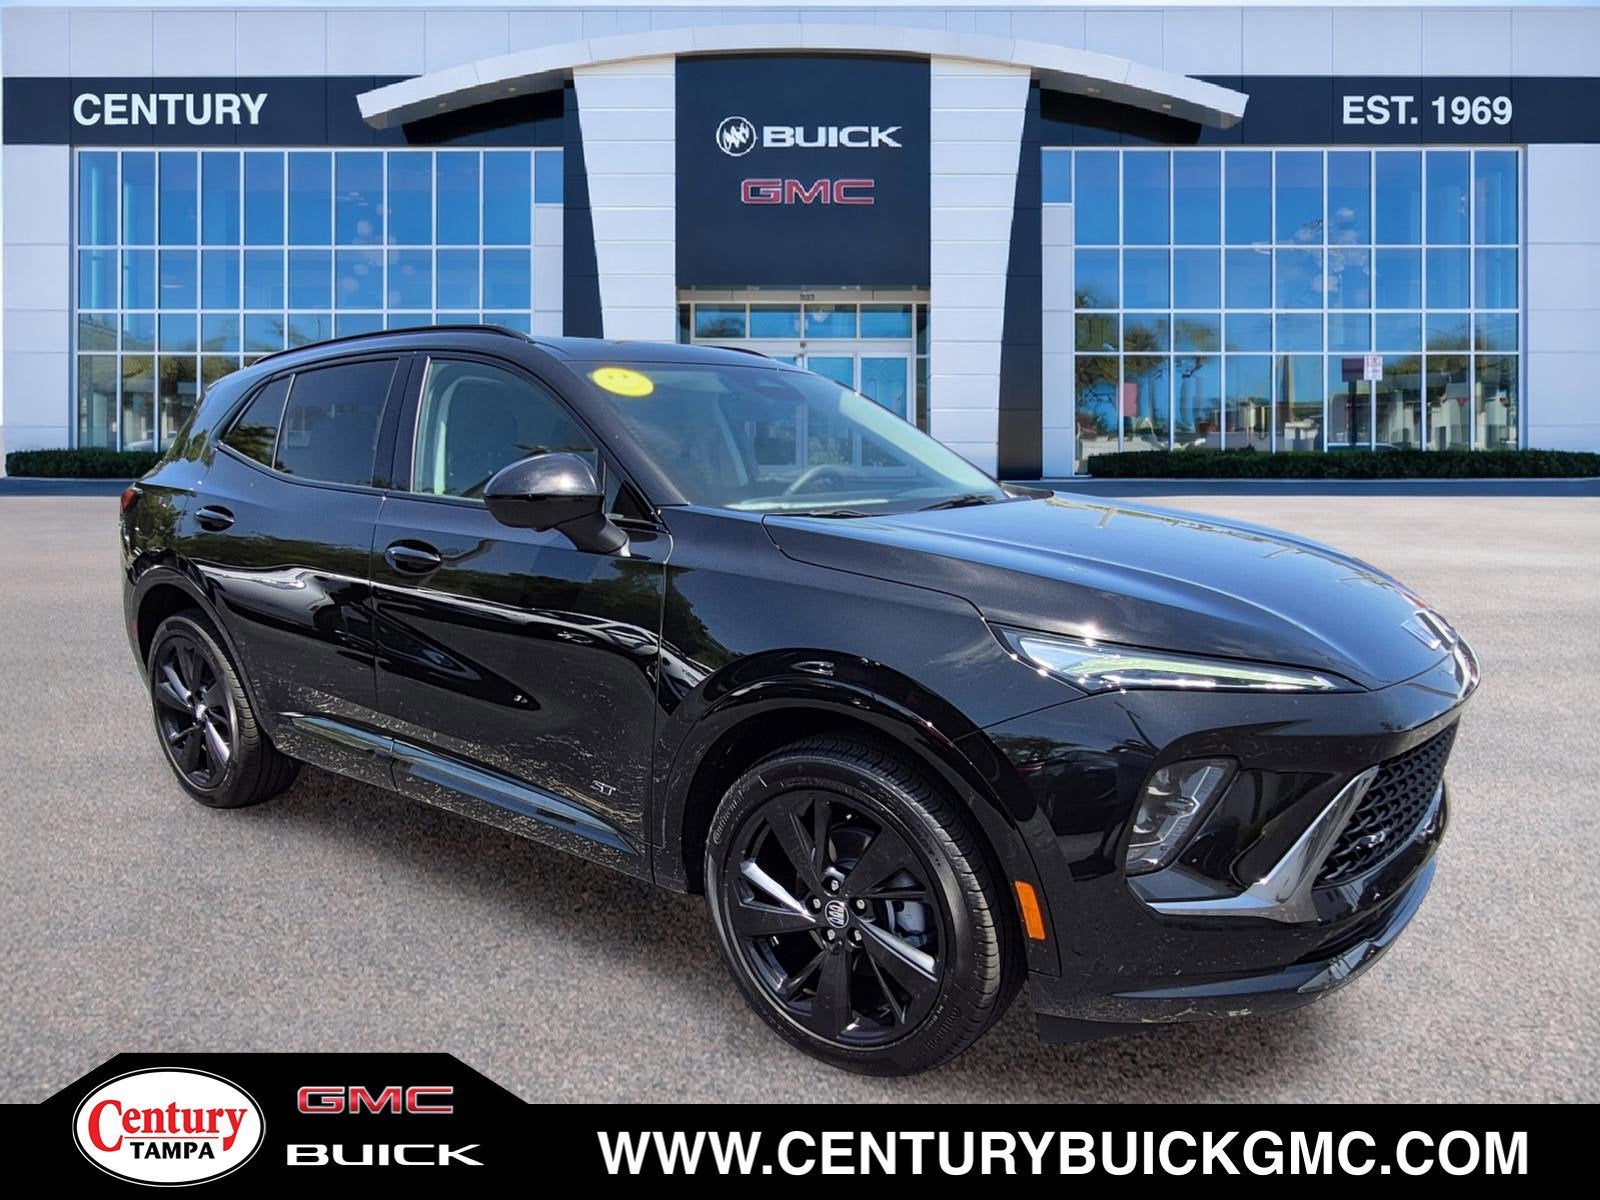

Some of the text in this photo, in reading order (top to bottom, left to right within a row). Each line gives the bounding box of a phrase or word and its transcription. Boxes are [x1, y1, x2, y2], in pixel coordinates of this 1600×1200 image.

[73, 92, 268, 126] CENTURY
[1342, 95, 1513, 126] EST. 1969
[763, 126, 902, 148] BUICK
[741, 178, 875, 205] GMC
